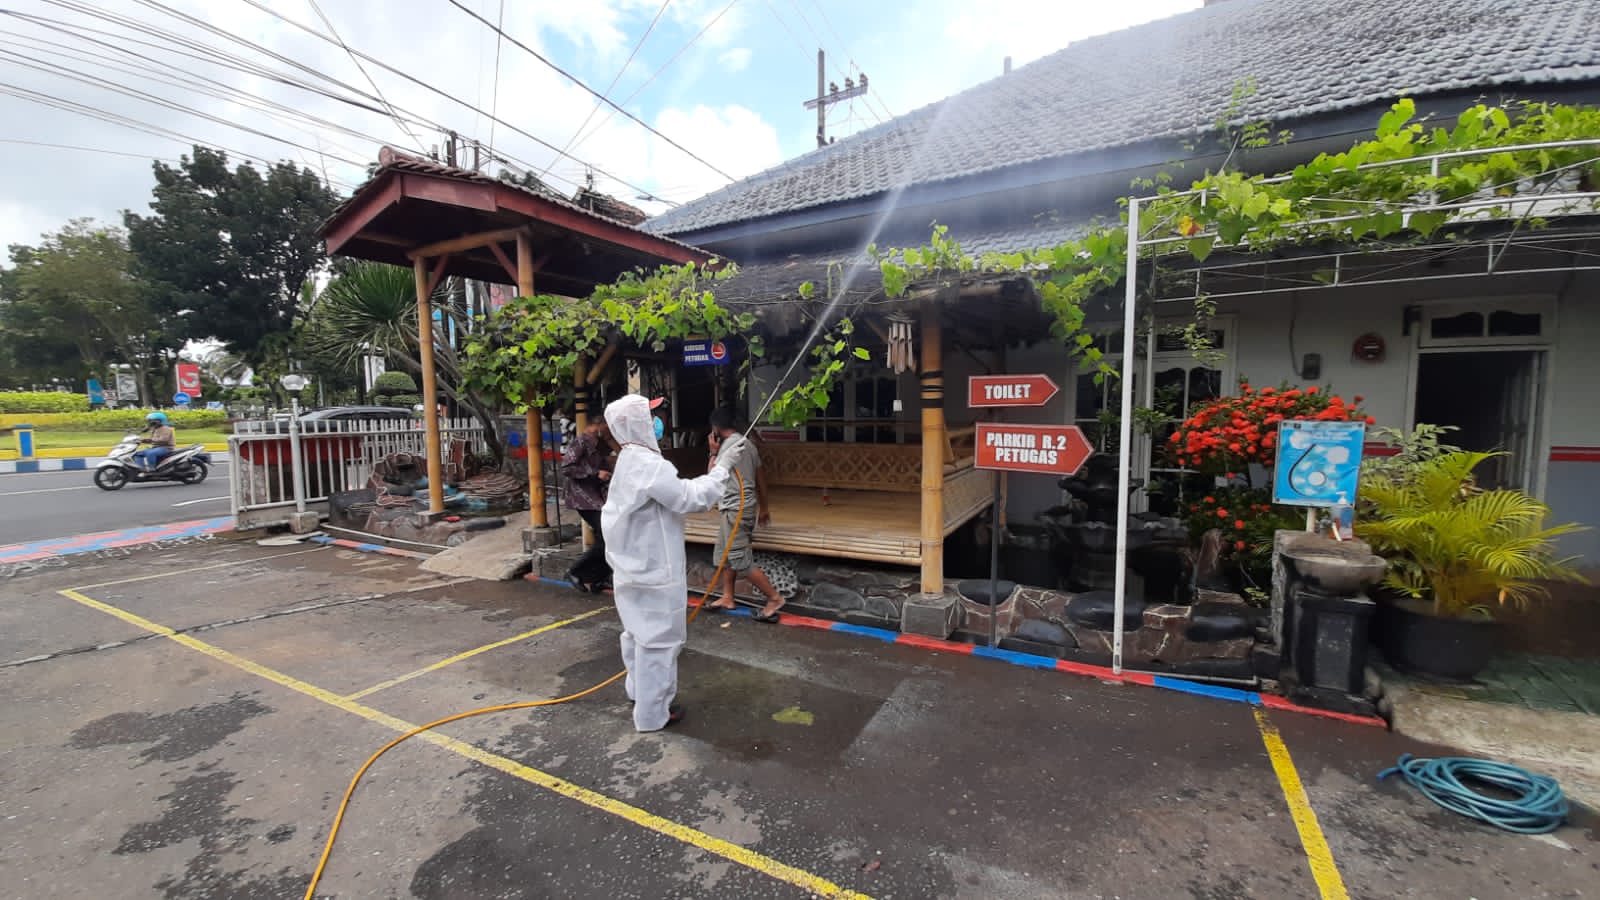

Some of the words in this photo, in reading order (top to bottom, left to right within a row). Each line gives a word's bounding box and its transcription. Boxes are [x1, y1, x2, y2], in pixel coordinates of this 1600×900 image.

[984, 384, 1031, 399] TOILET
[986, 432, 1036, 448] PARKIR
[1042, 435, 1066, 450] R.2
[995, 447, 1058, 465] PETUGAS
